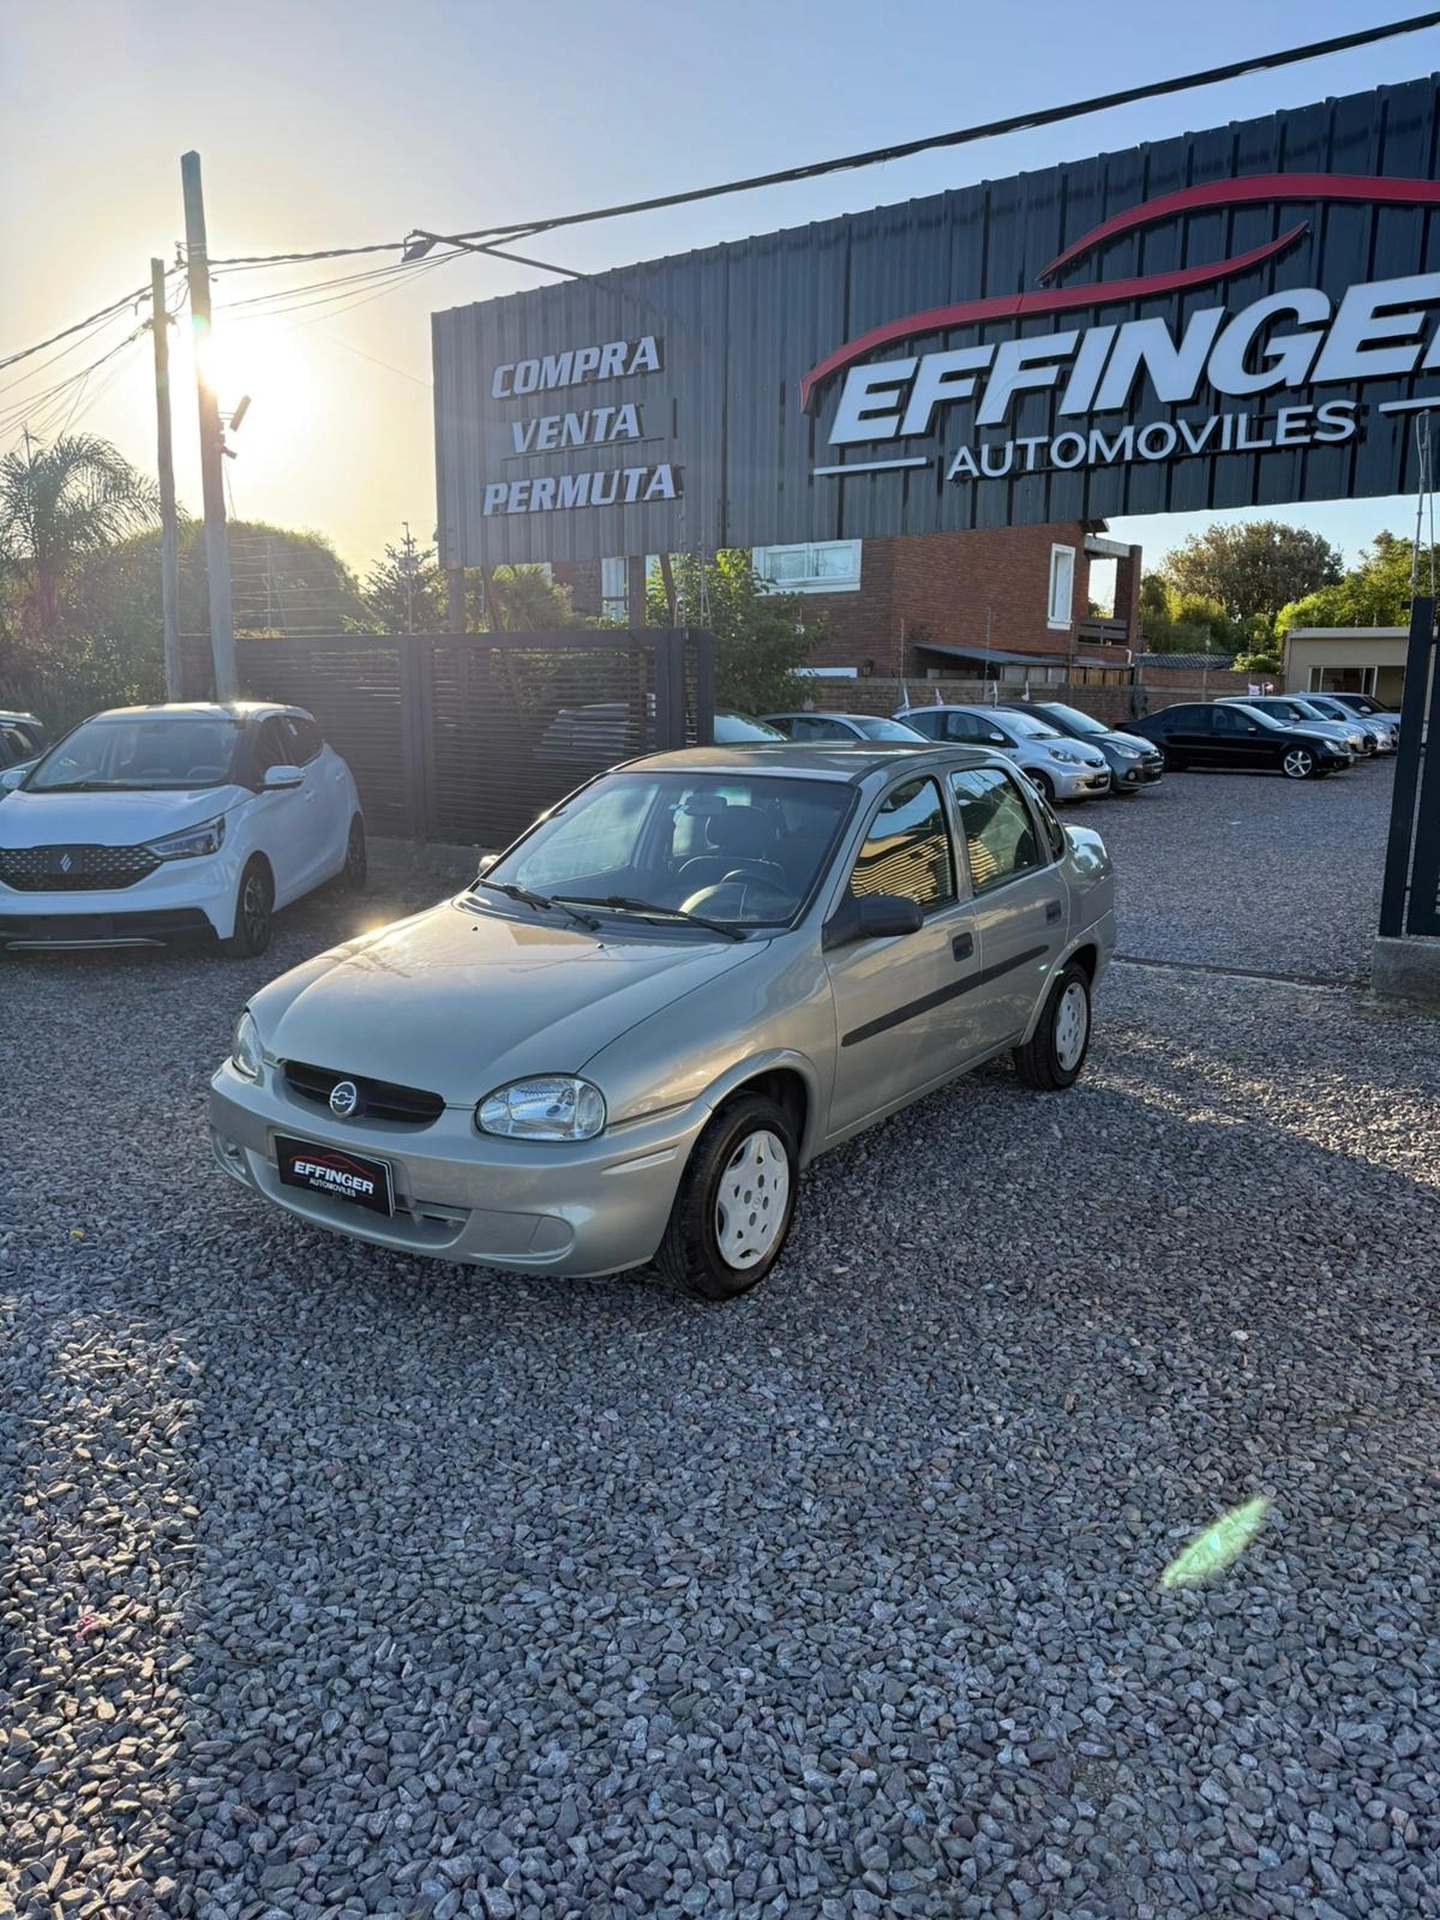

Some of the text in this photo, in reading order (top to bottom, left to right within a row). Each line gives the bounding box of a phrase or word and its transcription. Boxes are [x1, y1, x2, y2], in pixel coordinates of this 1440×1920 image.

[491, 335, 660, 399] COMPRA
[829, 271, 1440, 445] EFFINGE
[512, 403, 641, 453] VENTA
[946, 401, 1357, 481] AUTOMOVILES
[483, 463, 676, 517] PERMUTA
[294, 1160, 374, 1194] EFFINGER
[309, 1178, 356, 1197] AUTOMOVILES
